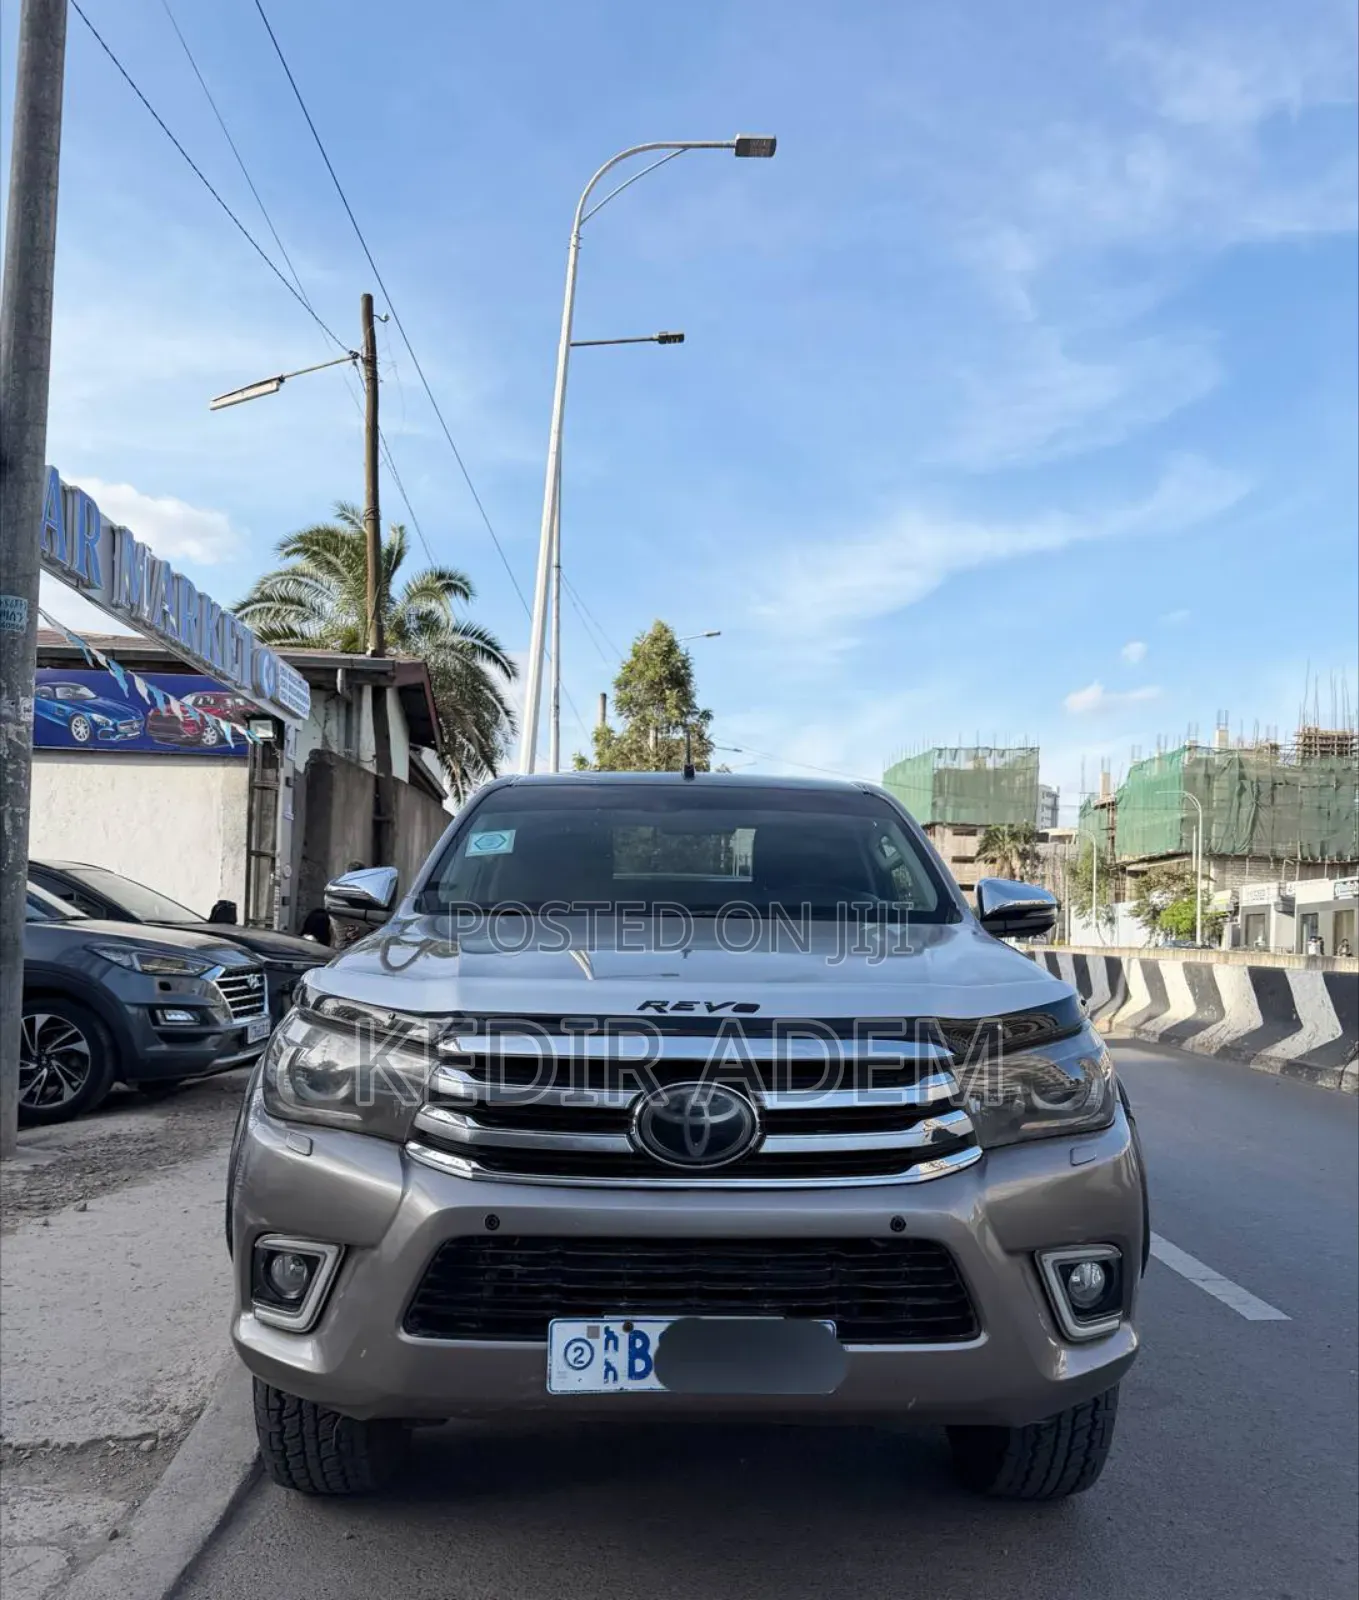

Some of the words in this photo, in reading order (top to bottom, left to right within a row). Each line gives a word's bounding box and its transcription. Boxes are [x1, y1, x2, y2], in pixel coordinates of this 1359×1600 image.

[113, 525, 254, 691] MARKET
[636, 1000, 761, 1014] REVO
[573, 1346, 585, 1364] 2
